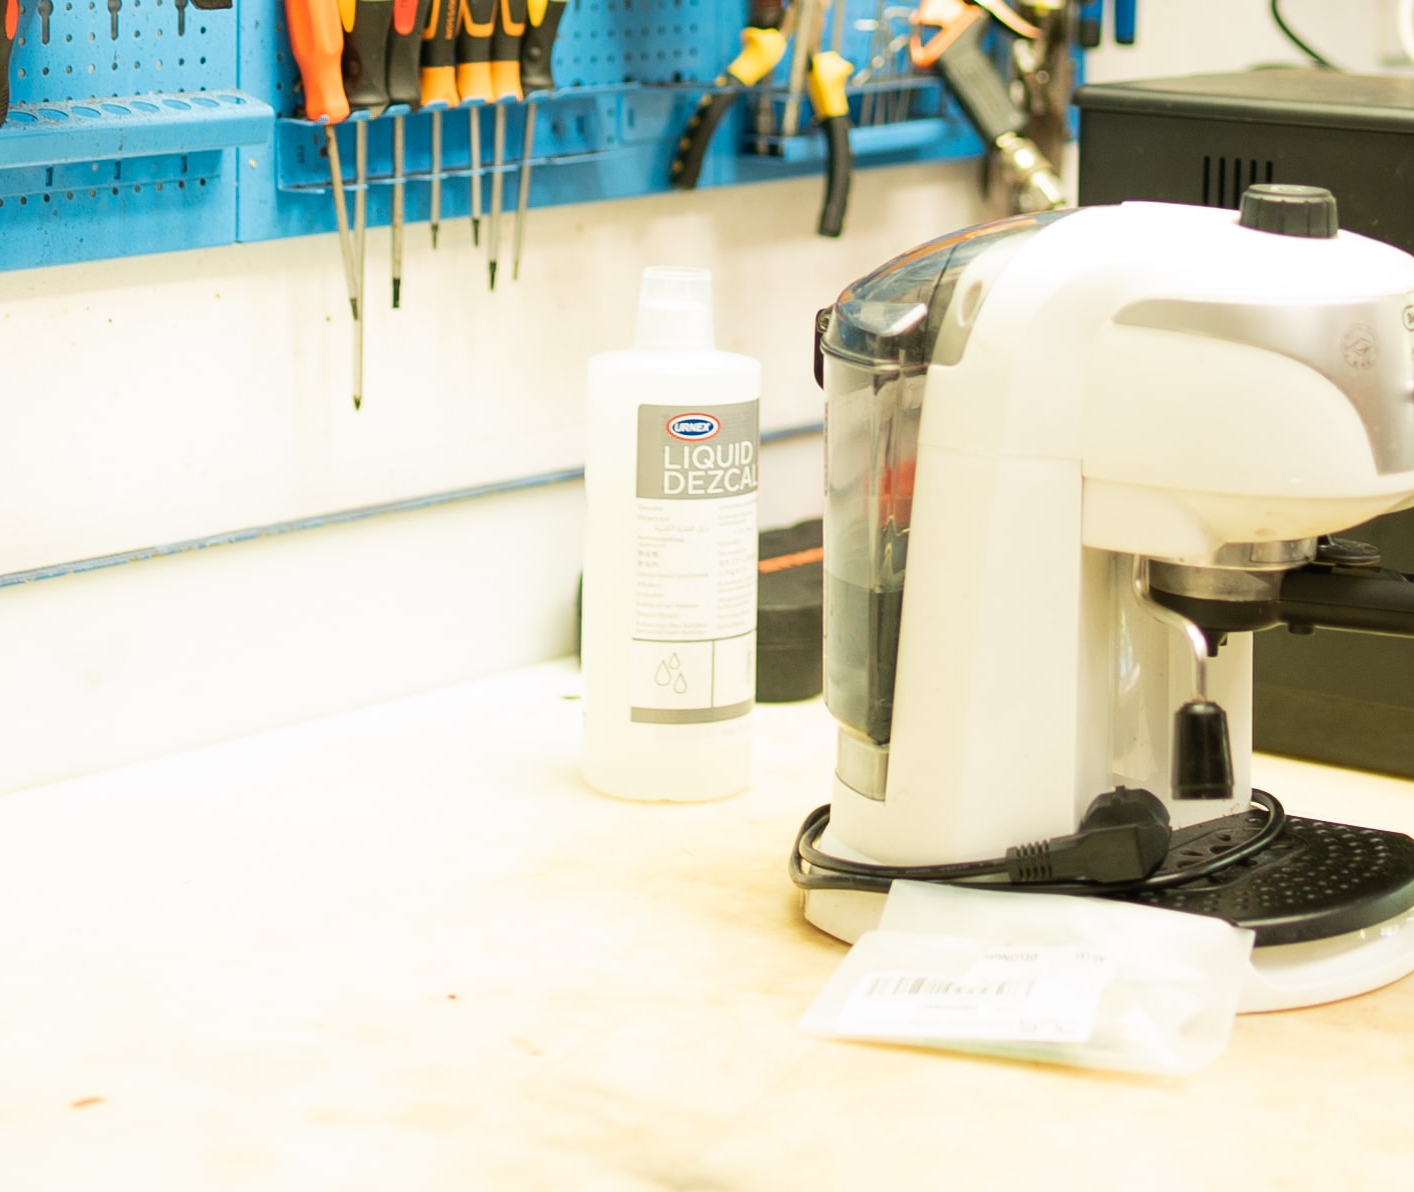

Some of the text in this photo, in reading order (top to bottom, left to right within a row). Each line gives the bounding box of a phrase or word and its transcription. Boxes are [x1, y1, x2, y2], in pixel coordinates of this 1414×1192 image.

[673, 421, 712, 433] URNEX
[664, 441, 753, 470] LIQUID
[663, 464, 758, 495] DEZCAL
